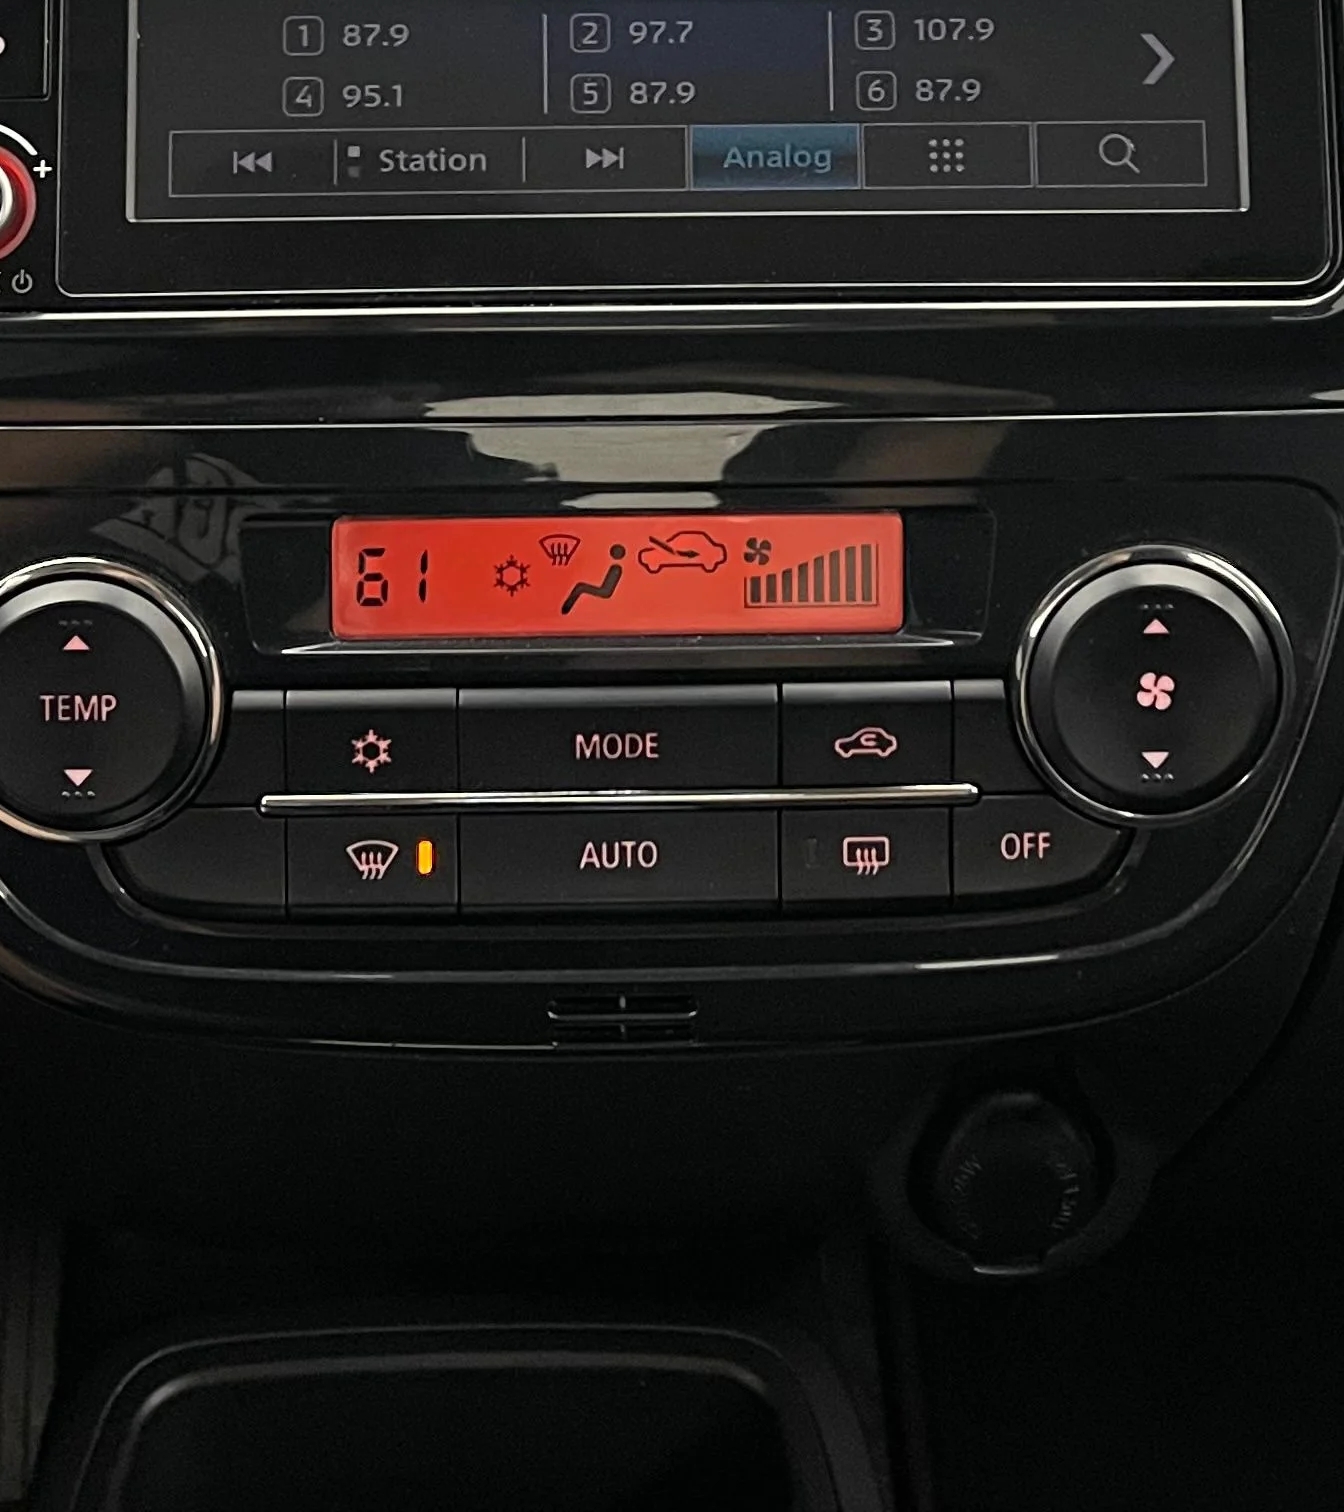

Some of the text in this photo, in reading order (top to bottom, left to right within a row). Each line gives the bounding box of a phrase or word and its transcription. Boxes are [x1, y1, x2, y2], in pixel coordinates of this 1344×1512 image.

[342, 24, 410, 47] 87.9
[580, 20, 694, 45] 2 97.7
[865, 17, 995, 42] 3 107.9
[295, 85, 403, 108] 4 95.1
[582, 82, 696, 105] 5 87.9
[867, 79, 981, 102] 6 87.9
[379, 148, 487, 173] Station
[722, 145, 833, 172] Analog
[355, 548, 429, 608] 61
[40, 695, 118, 722] TEMP
[574, 733, 659, 759] MODE
[579, 841, 658, 870] AUTO
[1000, 833, 1051, 860] OFF
